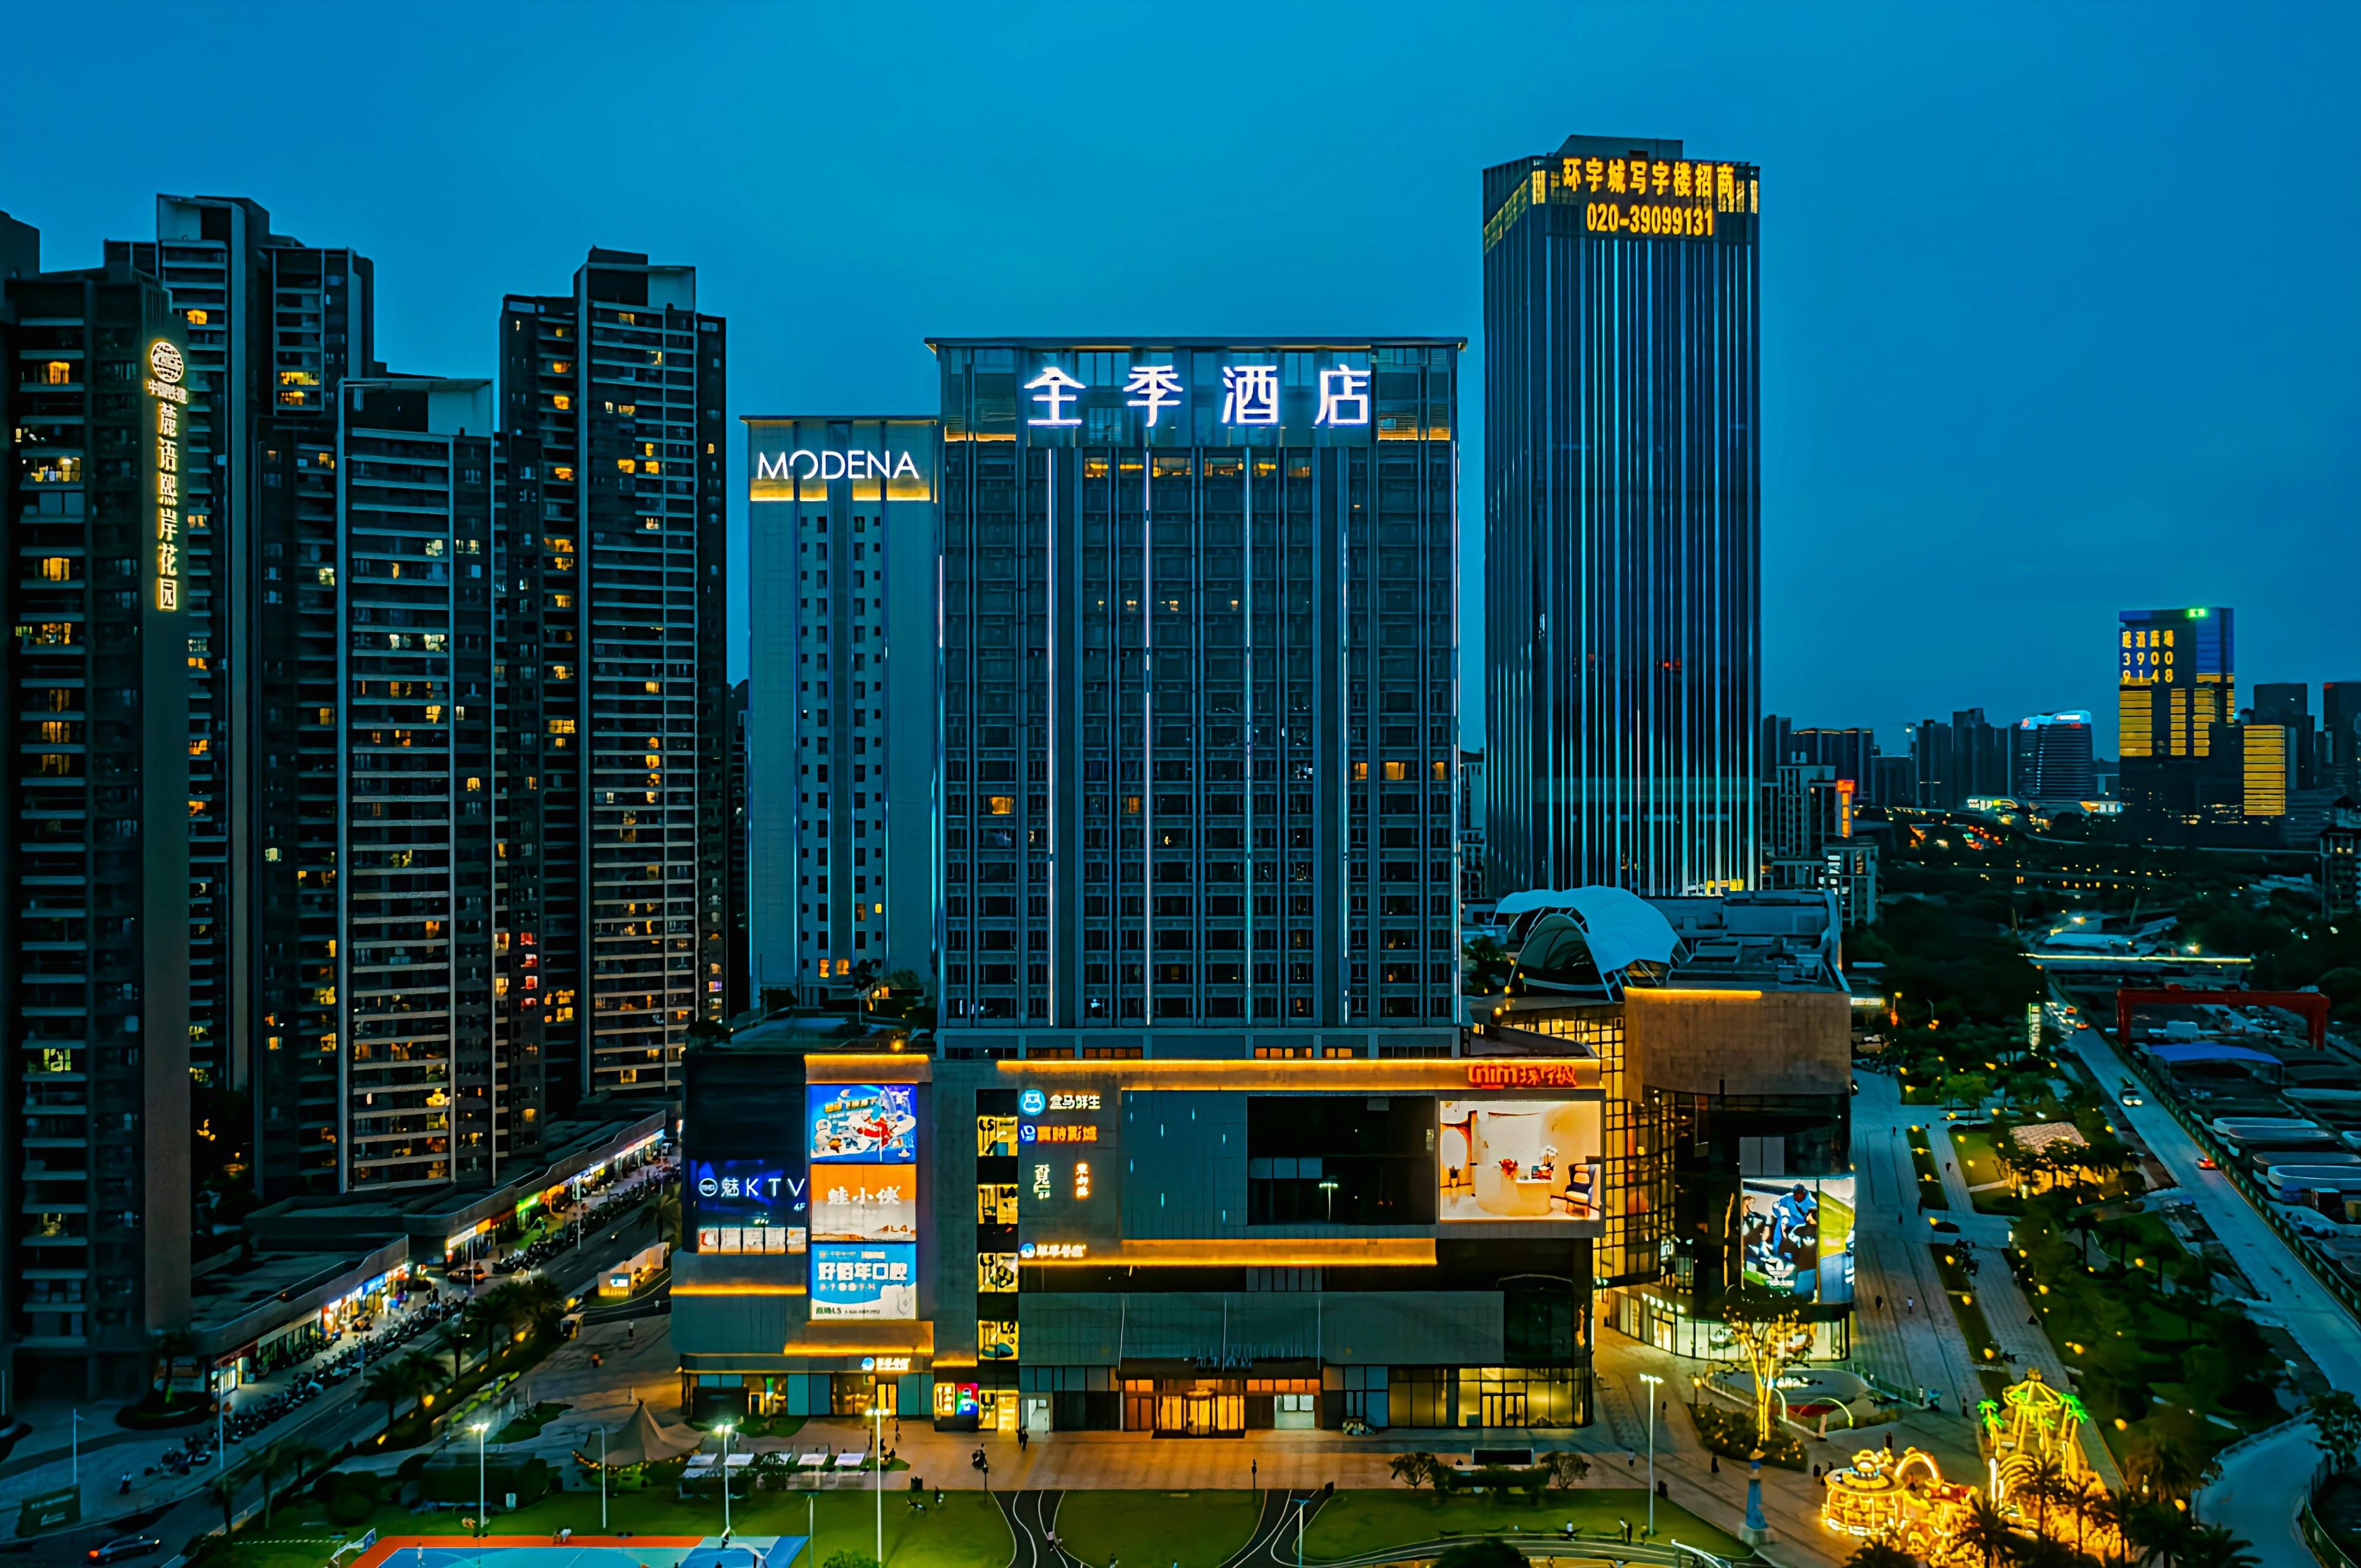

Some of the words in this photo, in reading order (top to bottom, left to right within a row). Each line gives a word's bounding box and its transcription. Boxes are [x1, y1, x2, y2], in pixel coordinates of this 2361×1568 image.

[1562, 157, 1734, 200] 环宇城写字楼招商
[1586, 202, 1713, 236] 020-39099131
[1023, 364, 1372, 427] 全季酒店
[756, 449, 920, 481] MODENA
[158, 402, 178, 611] 麓语熙岸花园
[2122, 651, 2174, 666] 3900
[2122, 668, 2174, 683] 9148
[1050, 1094, 1101, 1110] 盒马鲜生
